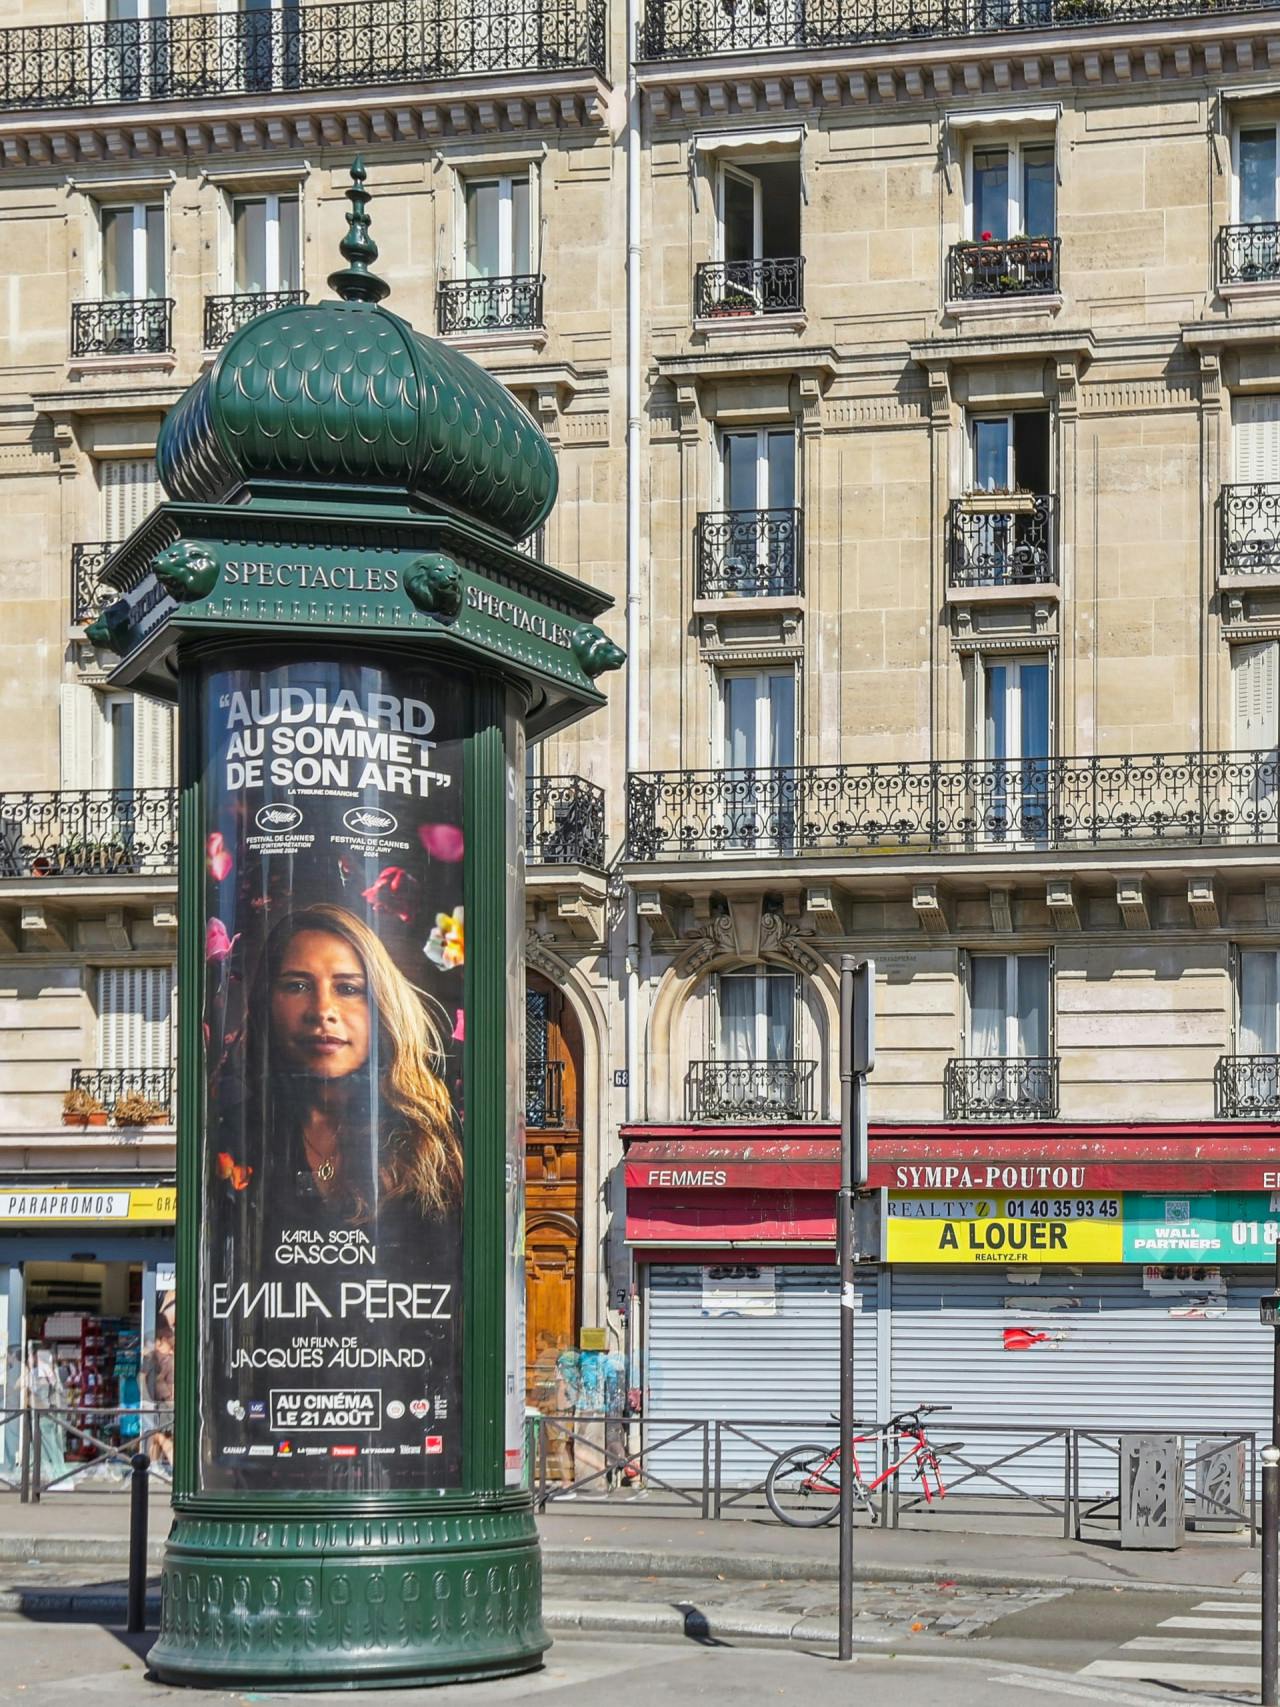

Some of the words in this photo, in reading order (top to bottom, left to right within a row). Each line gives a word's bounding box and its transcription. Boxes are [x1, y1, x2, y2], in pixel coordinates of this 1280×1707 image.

[224, 561, 398, 591] SPECTACLES
[466, 586, 572, 649] SPECTACLES
[226, 728, 264, 760] AU
[271, 726, 437, 767] SOMMET
[227, 759, 264, 790] DE
[270, 757, 348, 787] SON
[287, 788, 297, 796] LA
[297, 788, 324, 796] TRIBUNE
[324, 790, 359, 798] DIMANCHE
[246, 836, 274, 844] FESTIVAL
[284, 834, 315, 842] CANNES
[330, 835, 366, 845] FESTIVAL
[378, 840, 410, 850] CANNES
[615, 1071, 629, 1086] 68
[648, 1170, 727, 1186] FEMMES
[896, 1166, 1086, 1189] SYMPA-POUTOU
[8, 1196, 114, 1214] PARAPROMOS
[1007, 1200, 1025, 1217] 01
[1030, 1200, 1049, 1217] 40
[1053, 1200, 1072, 1217] 35
[1076, 1200, 1095, 1217] 93
[1099, 1200, 1118, 1217] 45
[281, 1230, 324, 1243] KARLA
[329, 1229, 369, 1243] SOFÍA
[938, 1223, 958, 1249] A
[969, 1222, 1068, 1249] LOUER
[1155, 1228, 1200, 1238] WALL
[1231, 1219, 1258, 1245] 01
[1134, 1239, 1221, 1249] PARTNERS
[275, 1244, 376, 1264] GASCÓN
[975, 1253, 1028, 1261] REALTYZ.FR
[213, 1282, 332, 1319] EMILIA
[340, 1279, 451, 1319] PÉREZ
[292, 1337, 309, 1347] UN
[311, 1337, 339, 1347] FILM
[342, 1337, 357, 1347] DE
[231, 1349, 323, 1368] JACQUES
[328, 1349, 425, 1368] AUDIARD
[276, 1395, 301, 1409] AU
[303, 1392, 374, 1409] CINÉMA
[277, 1411, 298, 1426] LE
[300, 1411, 319, 1426] 21
[322, 1409, 375, 1426] AOÛT
